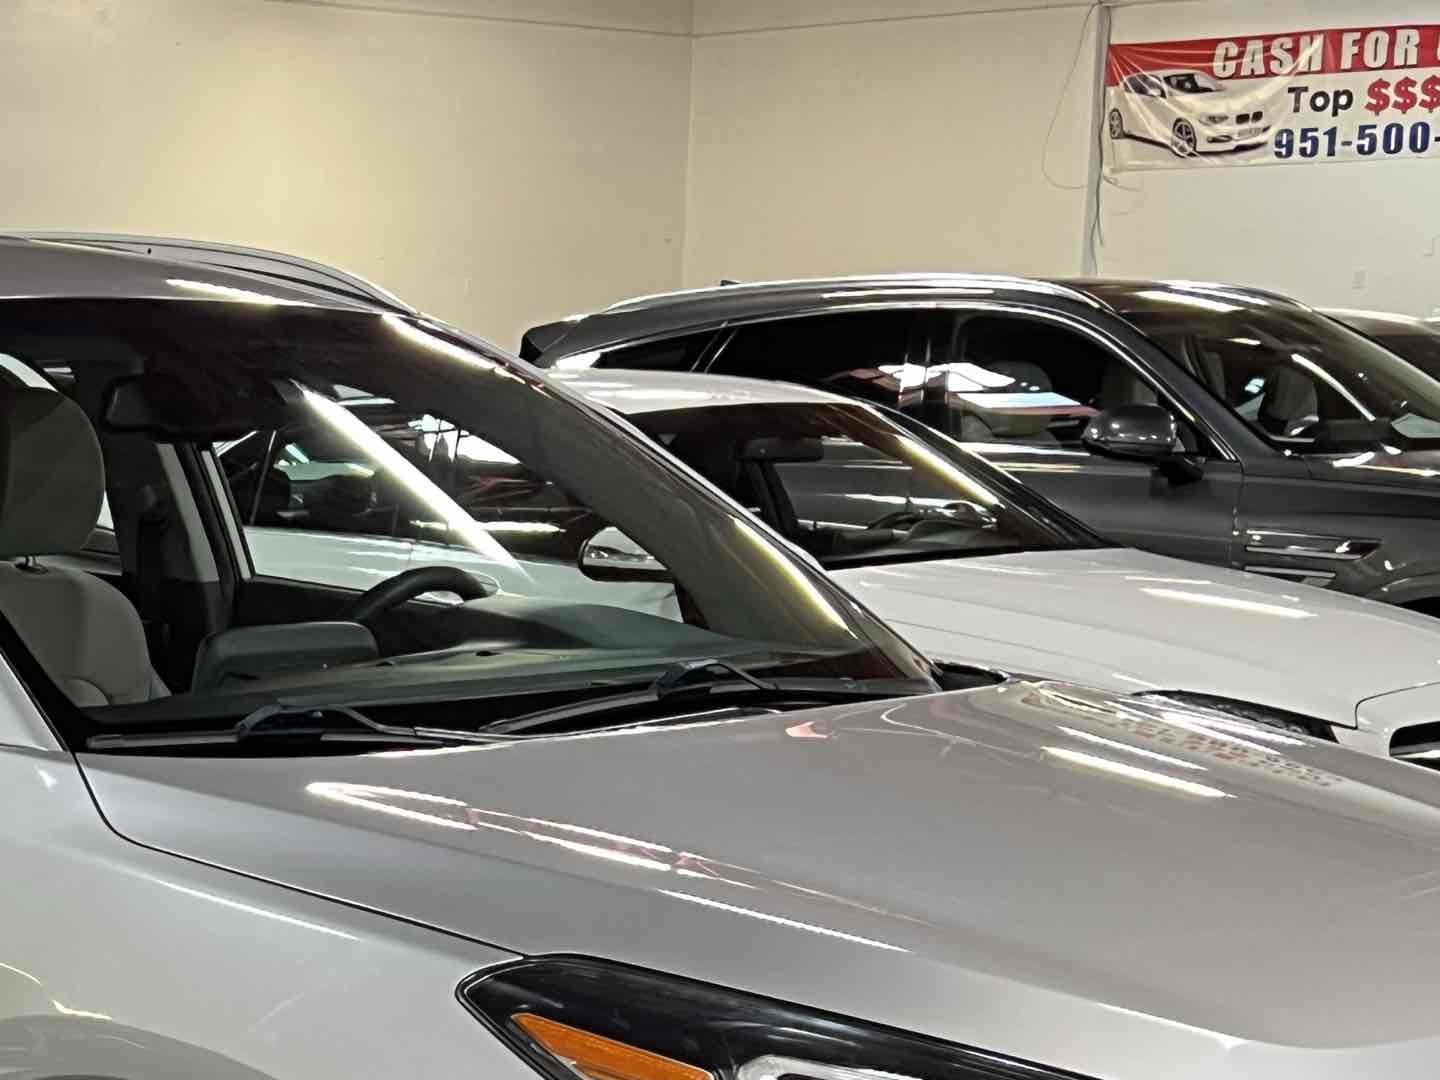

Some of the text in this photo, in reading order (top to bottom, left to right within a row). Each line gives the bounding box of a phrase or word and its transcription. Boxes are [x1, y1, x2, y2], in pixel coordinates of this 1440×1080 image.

[1212, 32, 1324, 79] CASH
[1340, 29, 1421, 70] FOR
[1287, 86, 1354, 117] Top
